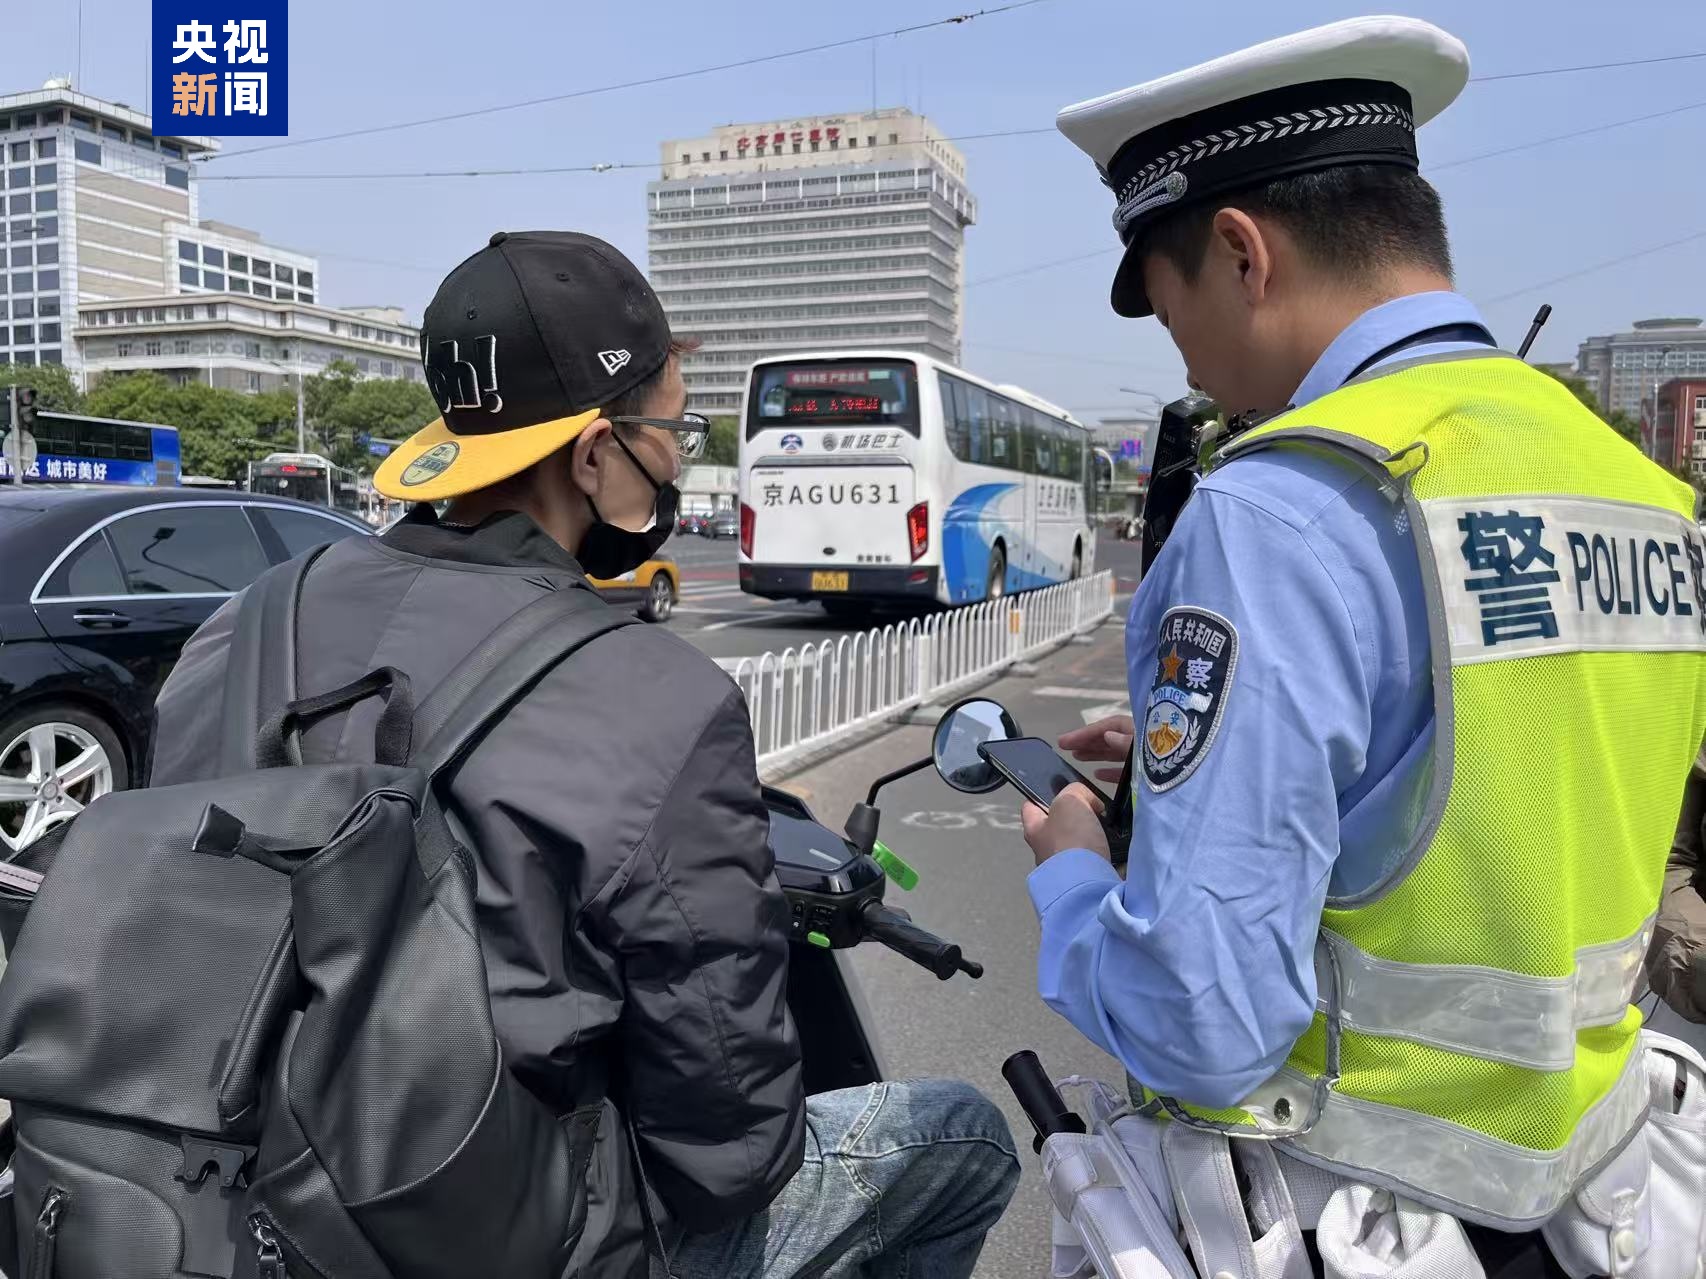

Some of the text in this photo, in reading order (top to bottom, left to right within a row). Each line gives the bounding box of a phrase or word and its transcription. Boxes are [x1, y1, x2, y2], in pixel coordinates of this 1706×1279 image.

[840, 433, 904, 450] 机场巴士
[46, 458, 108, 481] 城市美好
[763, 483, 900, 507] 京AGU631
[1457, 510, 1561, 646] 警
[1566, 531, 1693, 616] POLICE
[1160, 618, 1227, 658] 人民共和国
[1186, 657, 1213, 689] 察
[1153, 688, 1186, 705] POLICE
